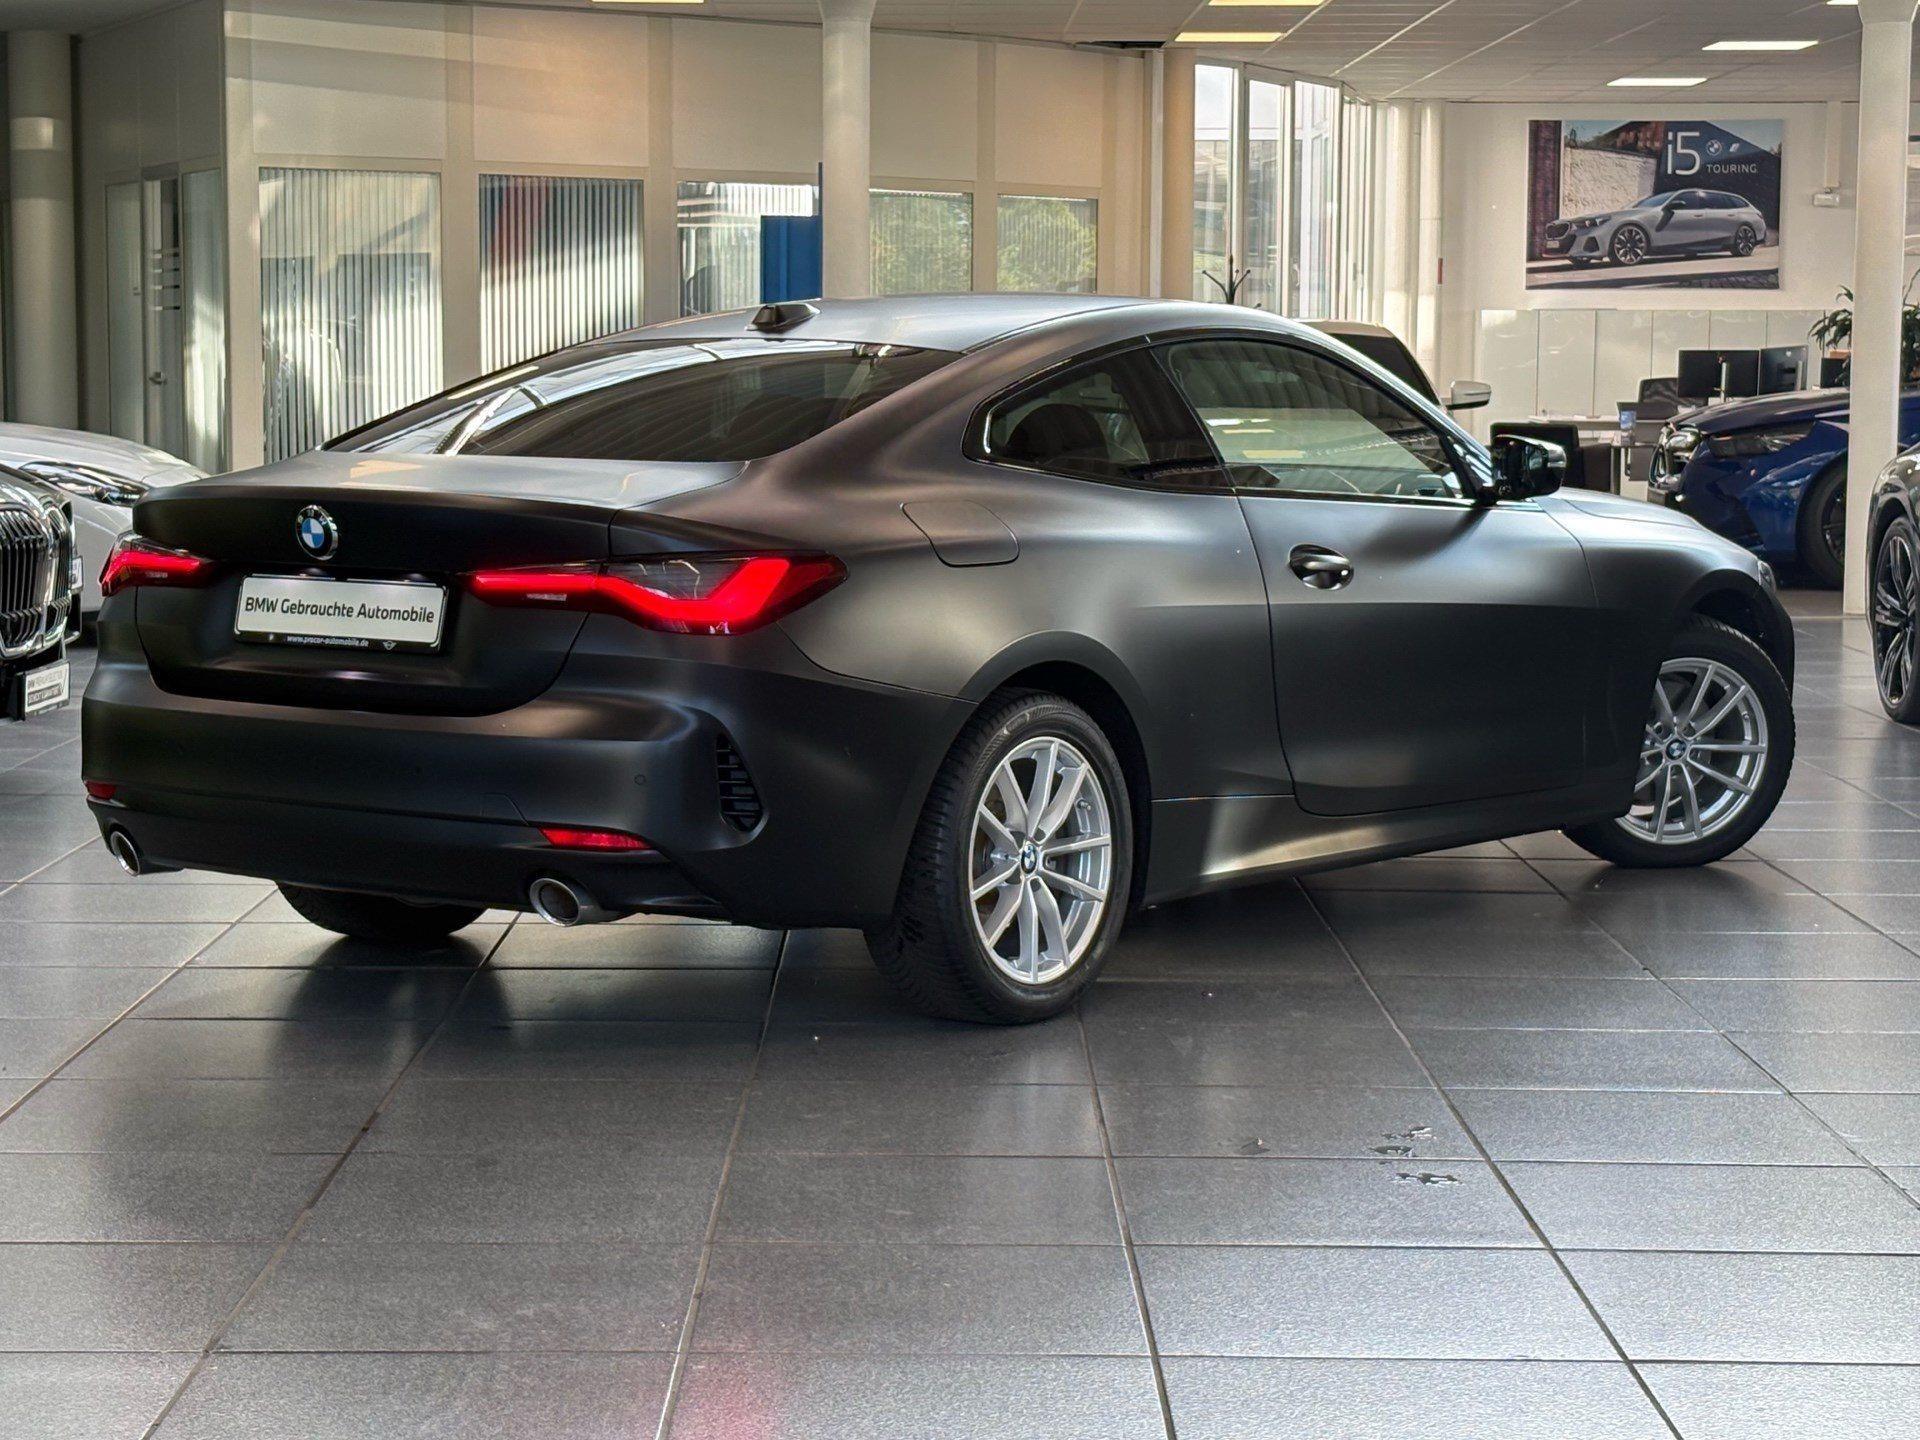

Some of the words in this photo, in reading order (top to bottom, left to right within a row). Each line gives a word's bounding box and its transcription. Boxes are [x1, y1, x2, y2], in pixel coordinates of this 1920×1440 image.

[1667, 131, 1700, 175] i5
[1706, 163, 1758, 174] TOURING
[244, 596, 279, 613] BMW
[280, 598, 354, 618] Gebrauchte
[356, 602, 435, 623] Automobile
